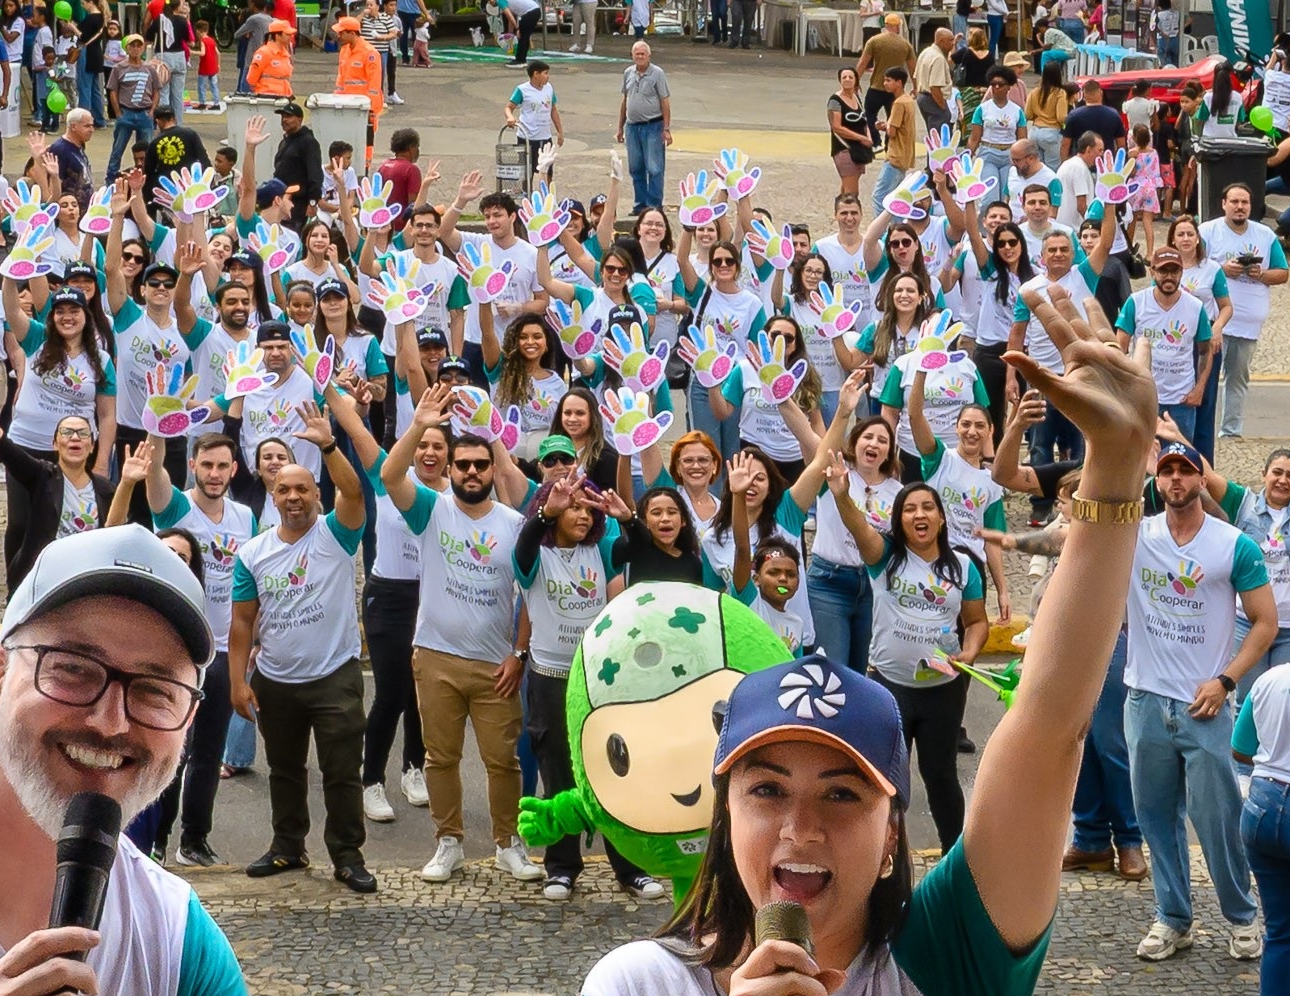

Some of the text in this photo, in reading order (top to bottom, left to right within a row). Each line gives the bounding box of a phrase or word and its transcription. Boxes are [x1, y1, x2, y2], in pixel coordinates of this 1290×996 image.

[123, 71, 149, 103] 7
[440, 530, 466, 552] Dia
[447, 551, 498, 575] Cooperar
[264, 575, 290, 590] Dia
[547, 578, 573, 595] Dia
[891, 575, 918, 596] Dia
[1141, 567, 1167, 587] Dia
[558, 596, 603, 612] Cooperar
[898, 594, 951, 615] Cooperar
[1149, 588, 1204, 610] Cooperar
